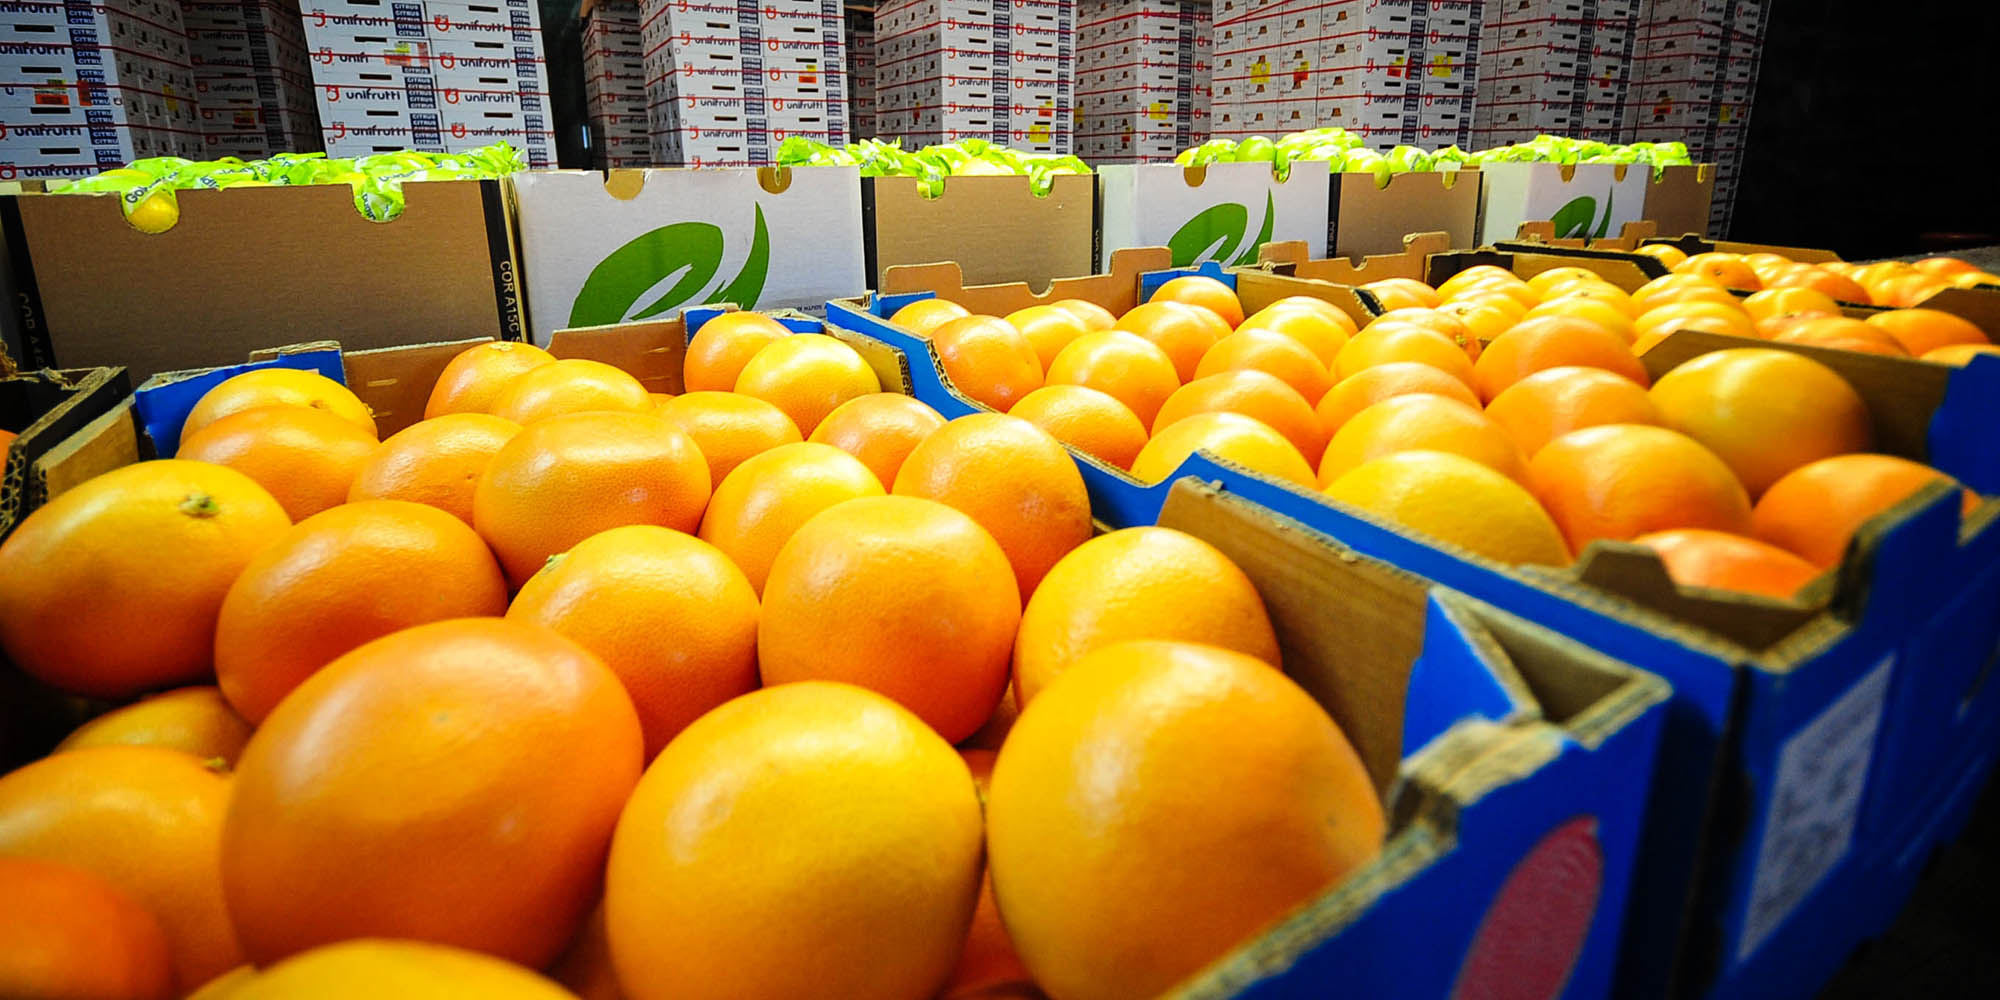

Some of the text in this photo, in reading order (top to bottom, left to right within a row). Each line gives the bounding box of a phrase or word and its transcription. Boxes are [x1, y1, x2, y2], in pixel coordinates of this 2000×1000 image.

[333, 13, 389, 27] unifrutti
[346, 88, 401, 100] unifrutti
[465, 91, 515, 103] unifrutti
[352, 125, 406, 137] unifrutti
[500, 261, 514, 293] COR
